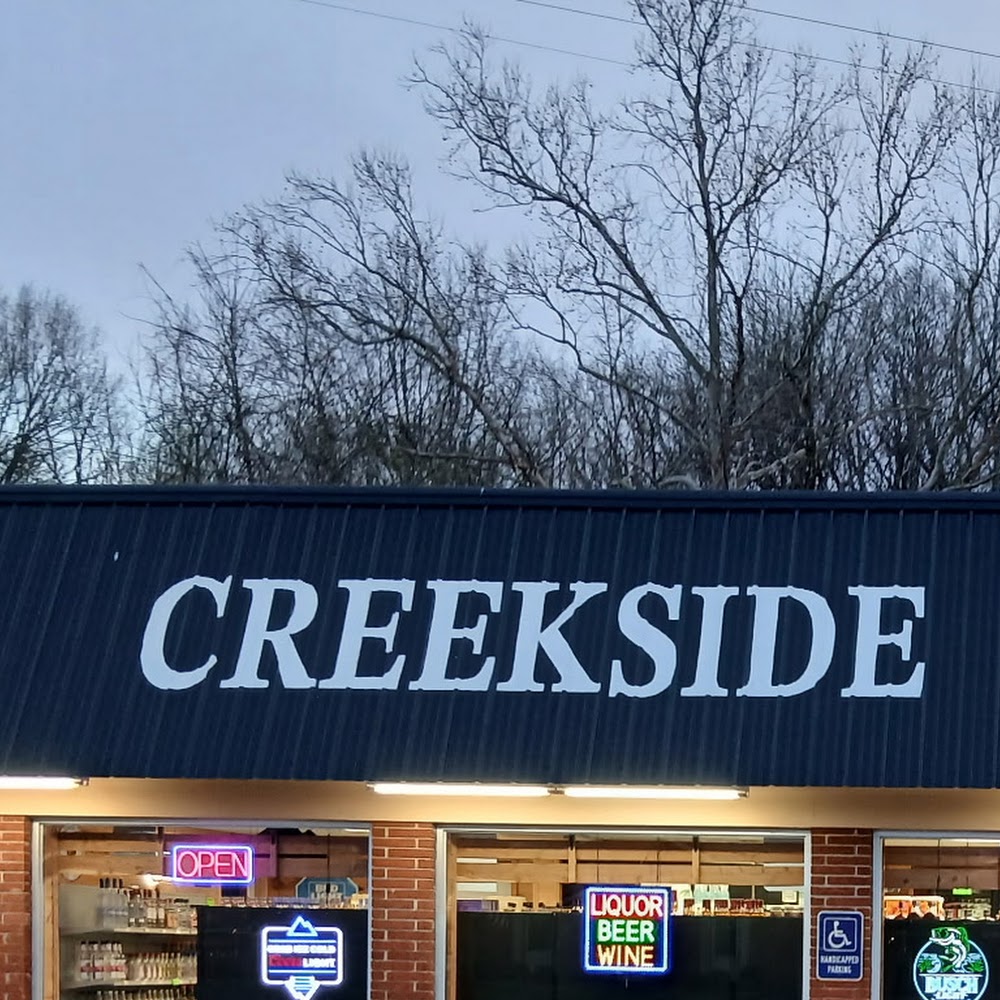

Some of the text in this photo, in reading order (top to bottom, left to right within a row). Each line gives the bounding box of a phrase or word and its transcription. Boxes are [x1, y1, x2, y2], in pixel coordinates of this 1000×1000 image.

[139, 575, 926, 698] CREEKSIDE
[178, 851, 248, 877] OPEN
[591, 893, 663, 917] LIQUOR
[597, 918, 655, 943] BEER
[597, 944, 654, 967] WINE
[820, 955, 860, 964] HANDICAPPED
[827, 965, 852, 974] PARKING
[925, 976, 979, 994] BUSCH
